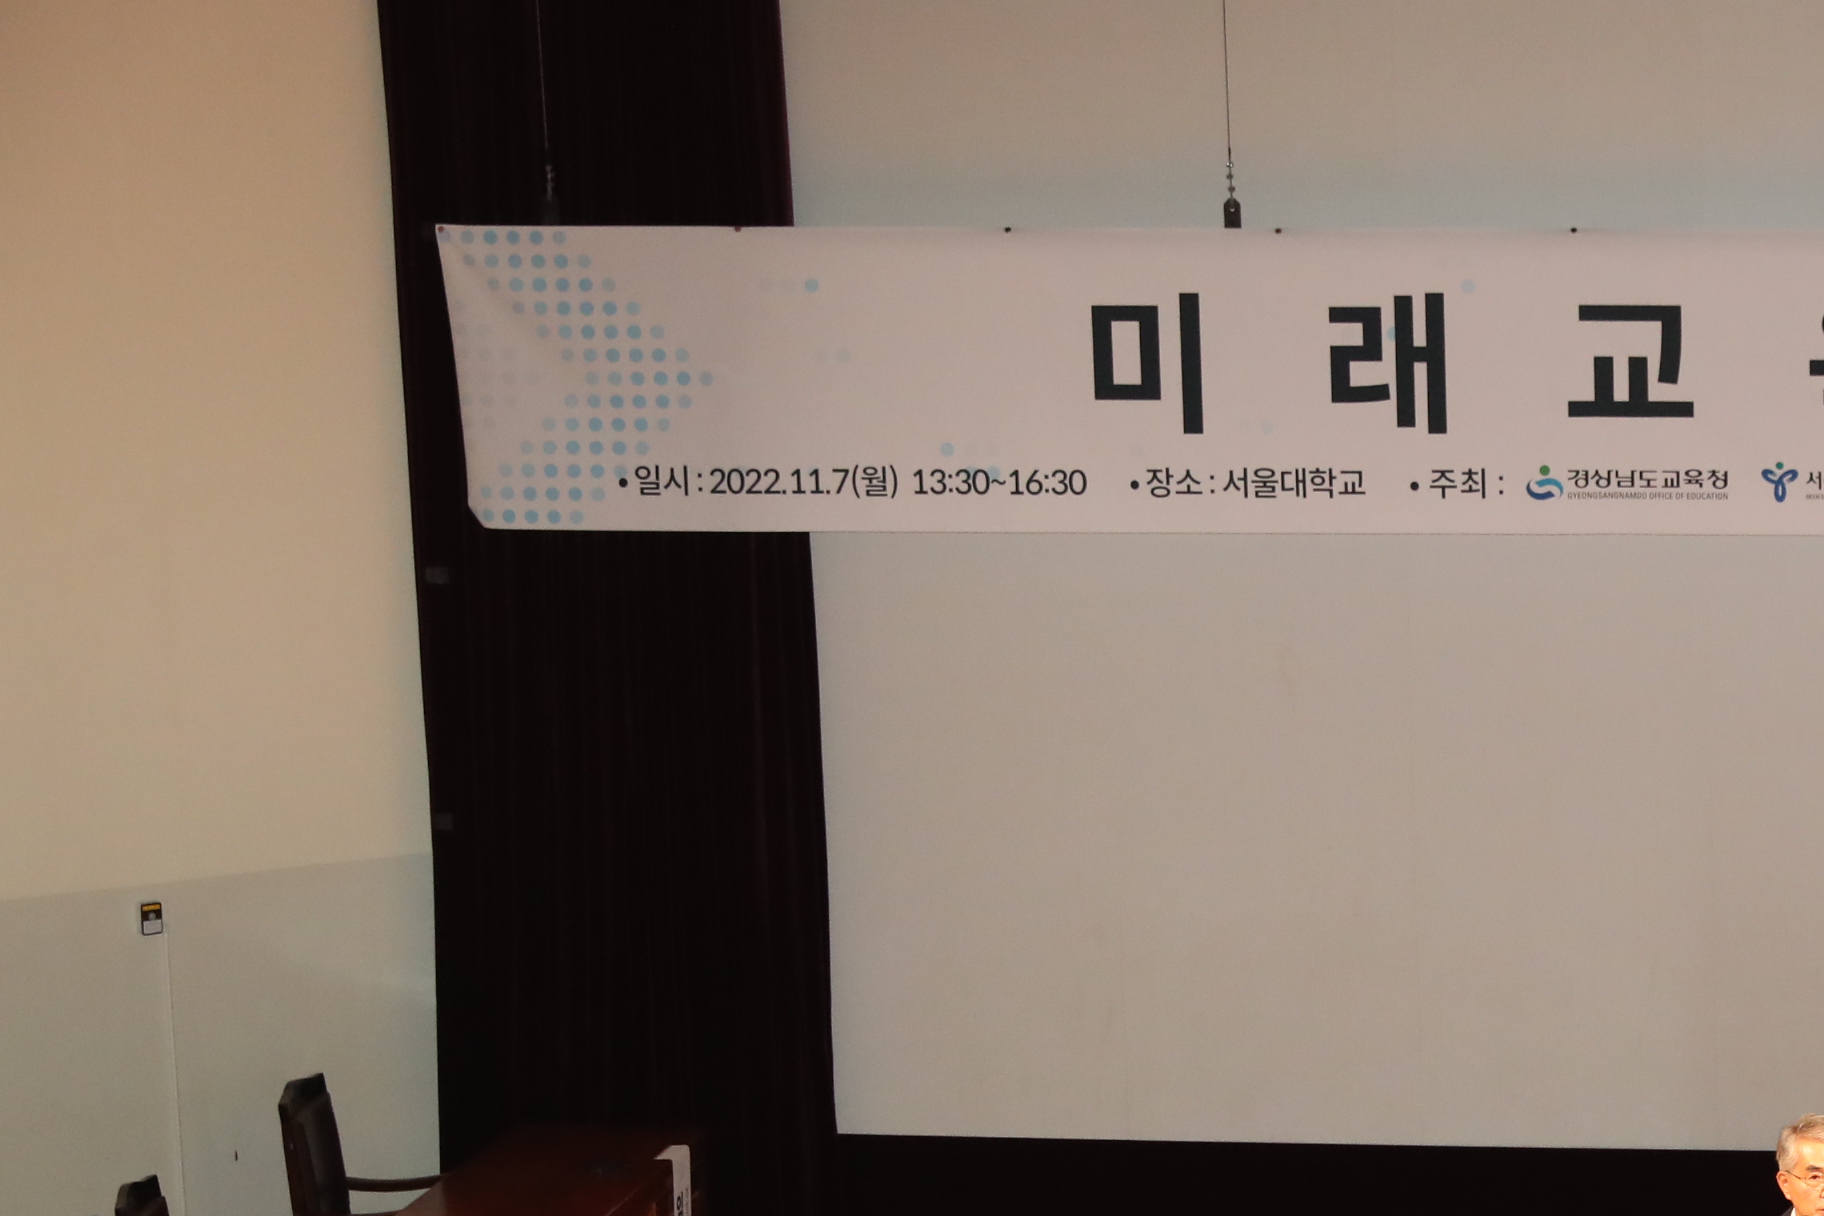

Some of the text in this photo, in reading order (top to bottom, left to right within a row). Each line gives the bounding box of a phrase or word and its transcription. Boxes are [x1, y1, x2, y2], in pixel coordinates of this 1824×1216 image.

[913, 468, 1087, 496] 13:30~16:30
[1223, 467, 1367, 499] 서울대학교
[1567, 469, 1729, 490] 경상남도교육청
[1650, 491, 1673, 501] OFFICE
[1675, 491, 1684, 501] OF
[1686, 491, 1729, 501] EDUCATION
